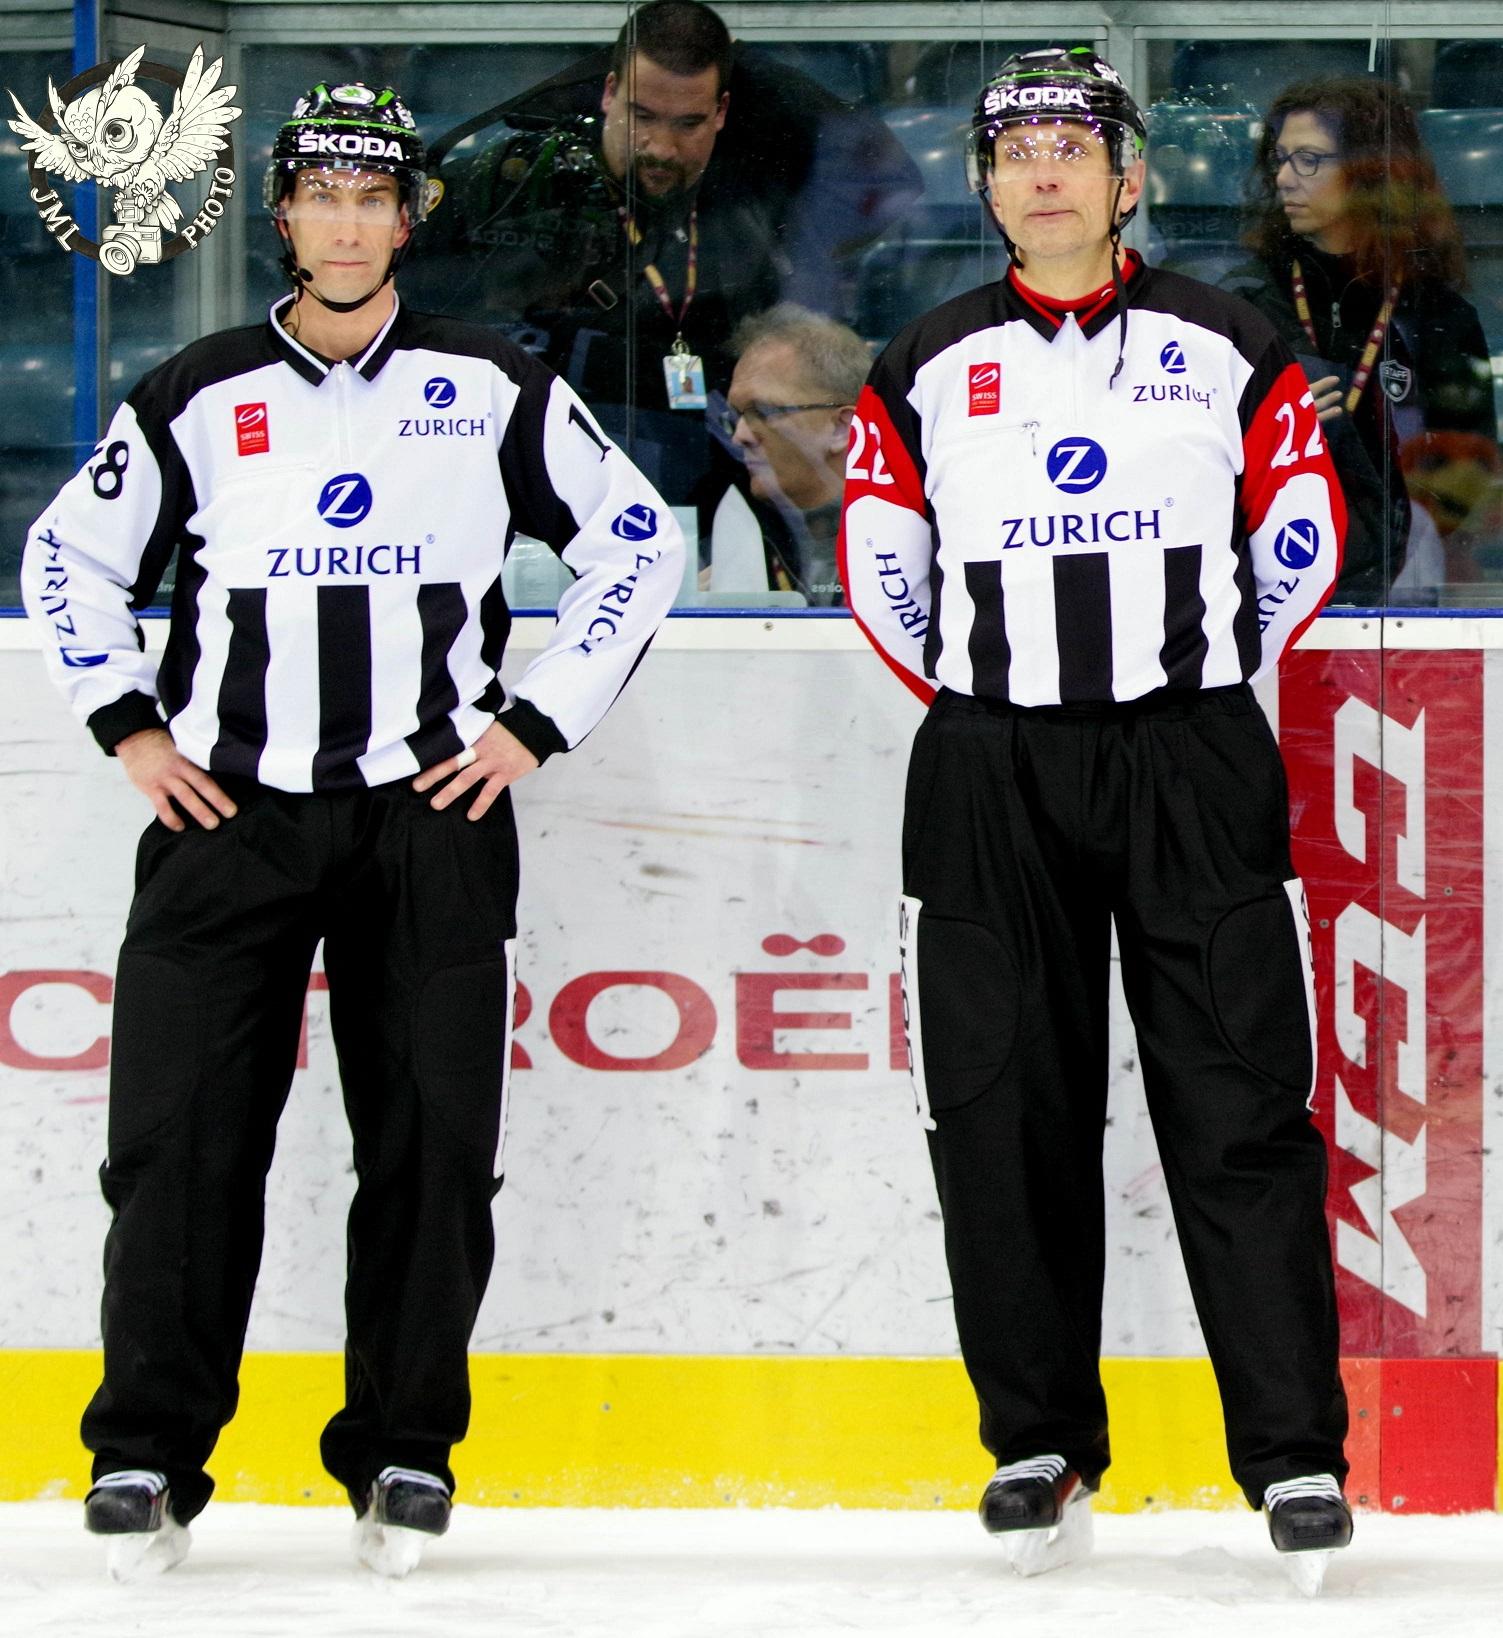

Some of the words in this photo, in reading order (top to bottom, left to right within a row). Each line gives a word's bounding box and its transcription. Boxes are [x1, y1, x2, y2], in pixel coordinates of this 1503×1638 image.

[1383, 366, 1408, 379] STAFF
[398, 418, 485, 436] ZURICH
[1271, 391, 1324, 469] 22
[89, 440, 129, 500] 8
[846, 414, 895, 485] 22
[1001, 509, 1162, 550] ZURICH
[266, 545, 421, 577] ZURICH
